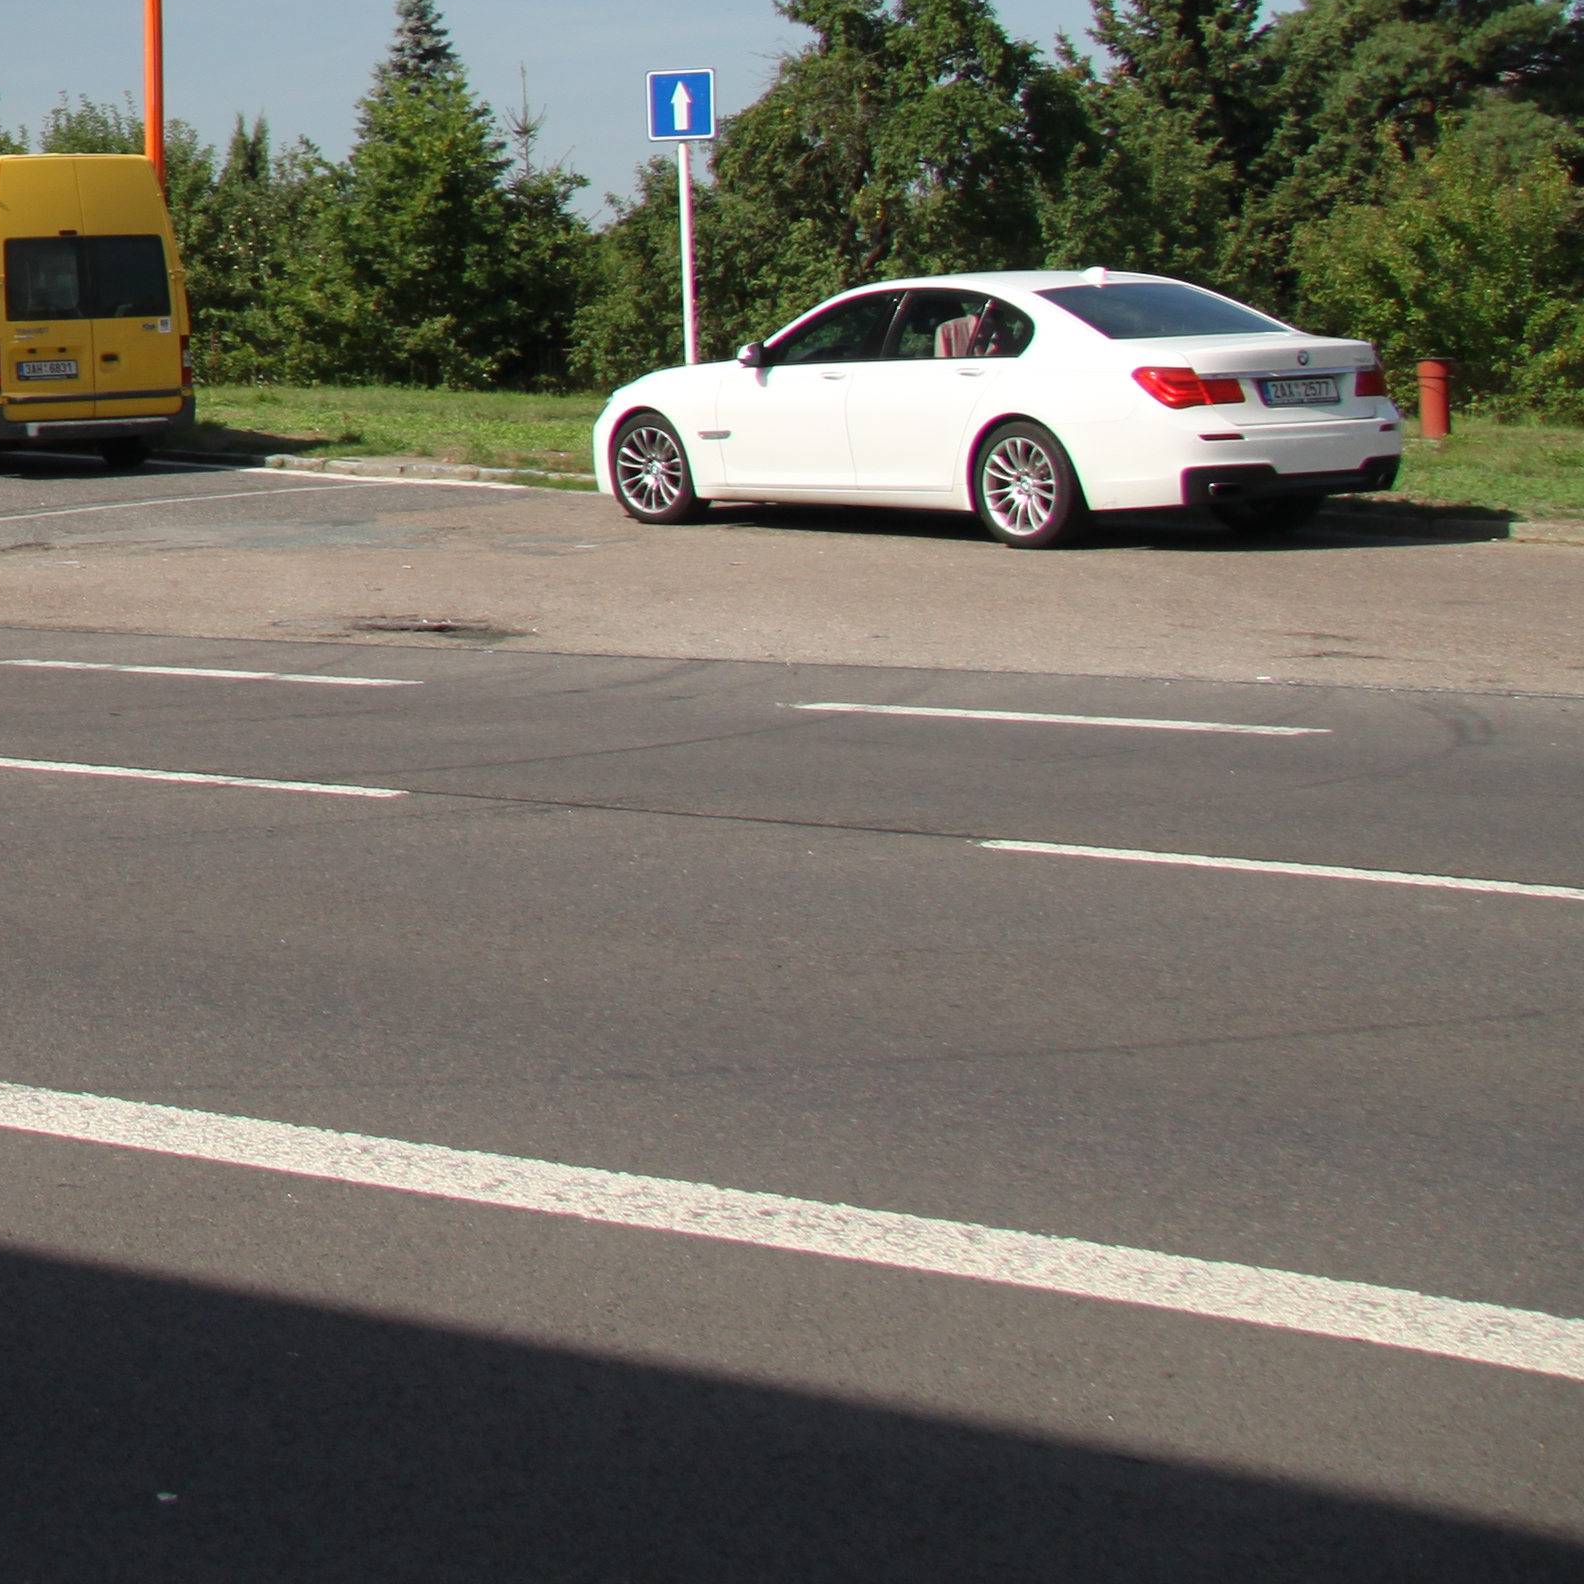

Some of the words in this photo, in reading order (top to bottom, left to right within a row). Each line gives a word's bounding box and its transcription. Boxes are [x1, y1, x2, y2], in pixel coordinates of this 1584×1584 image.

[25, 362, 43, 375] 3AH
[49, 361, 73, 374] 6831
[1270, 383, 1295, 399] 2AX
[1301, 381, 1329, 398] 2577
